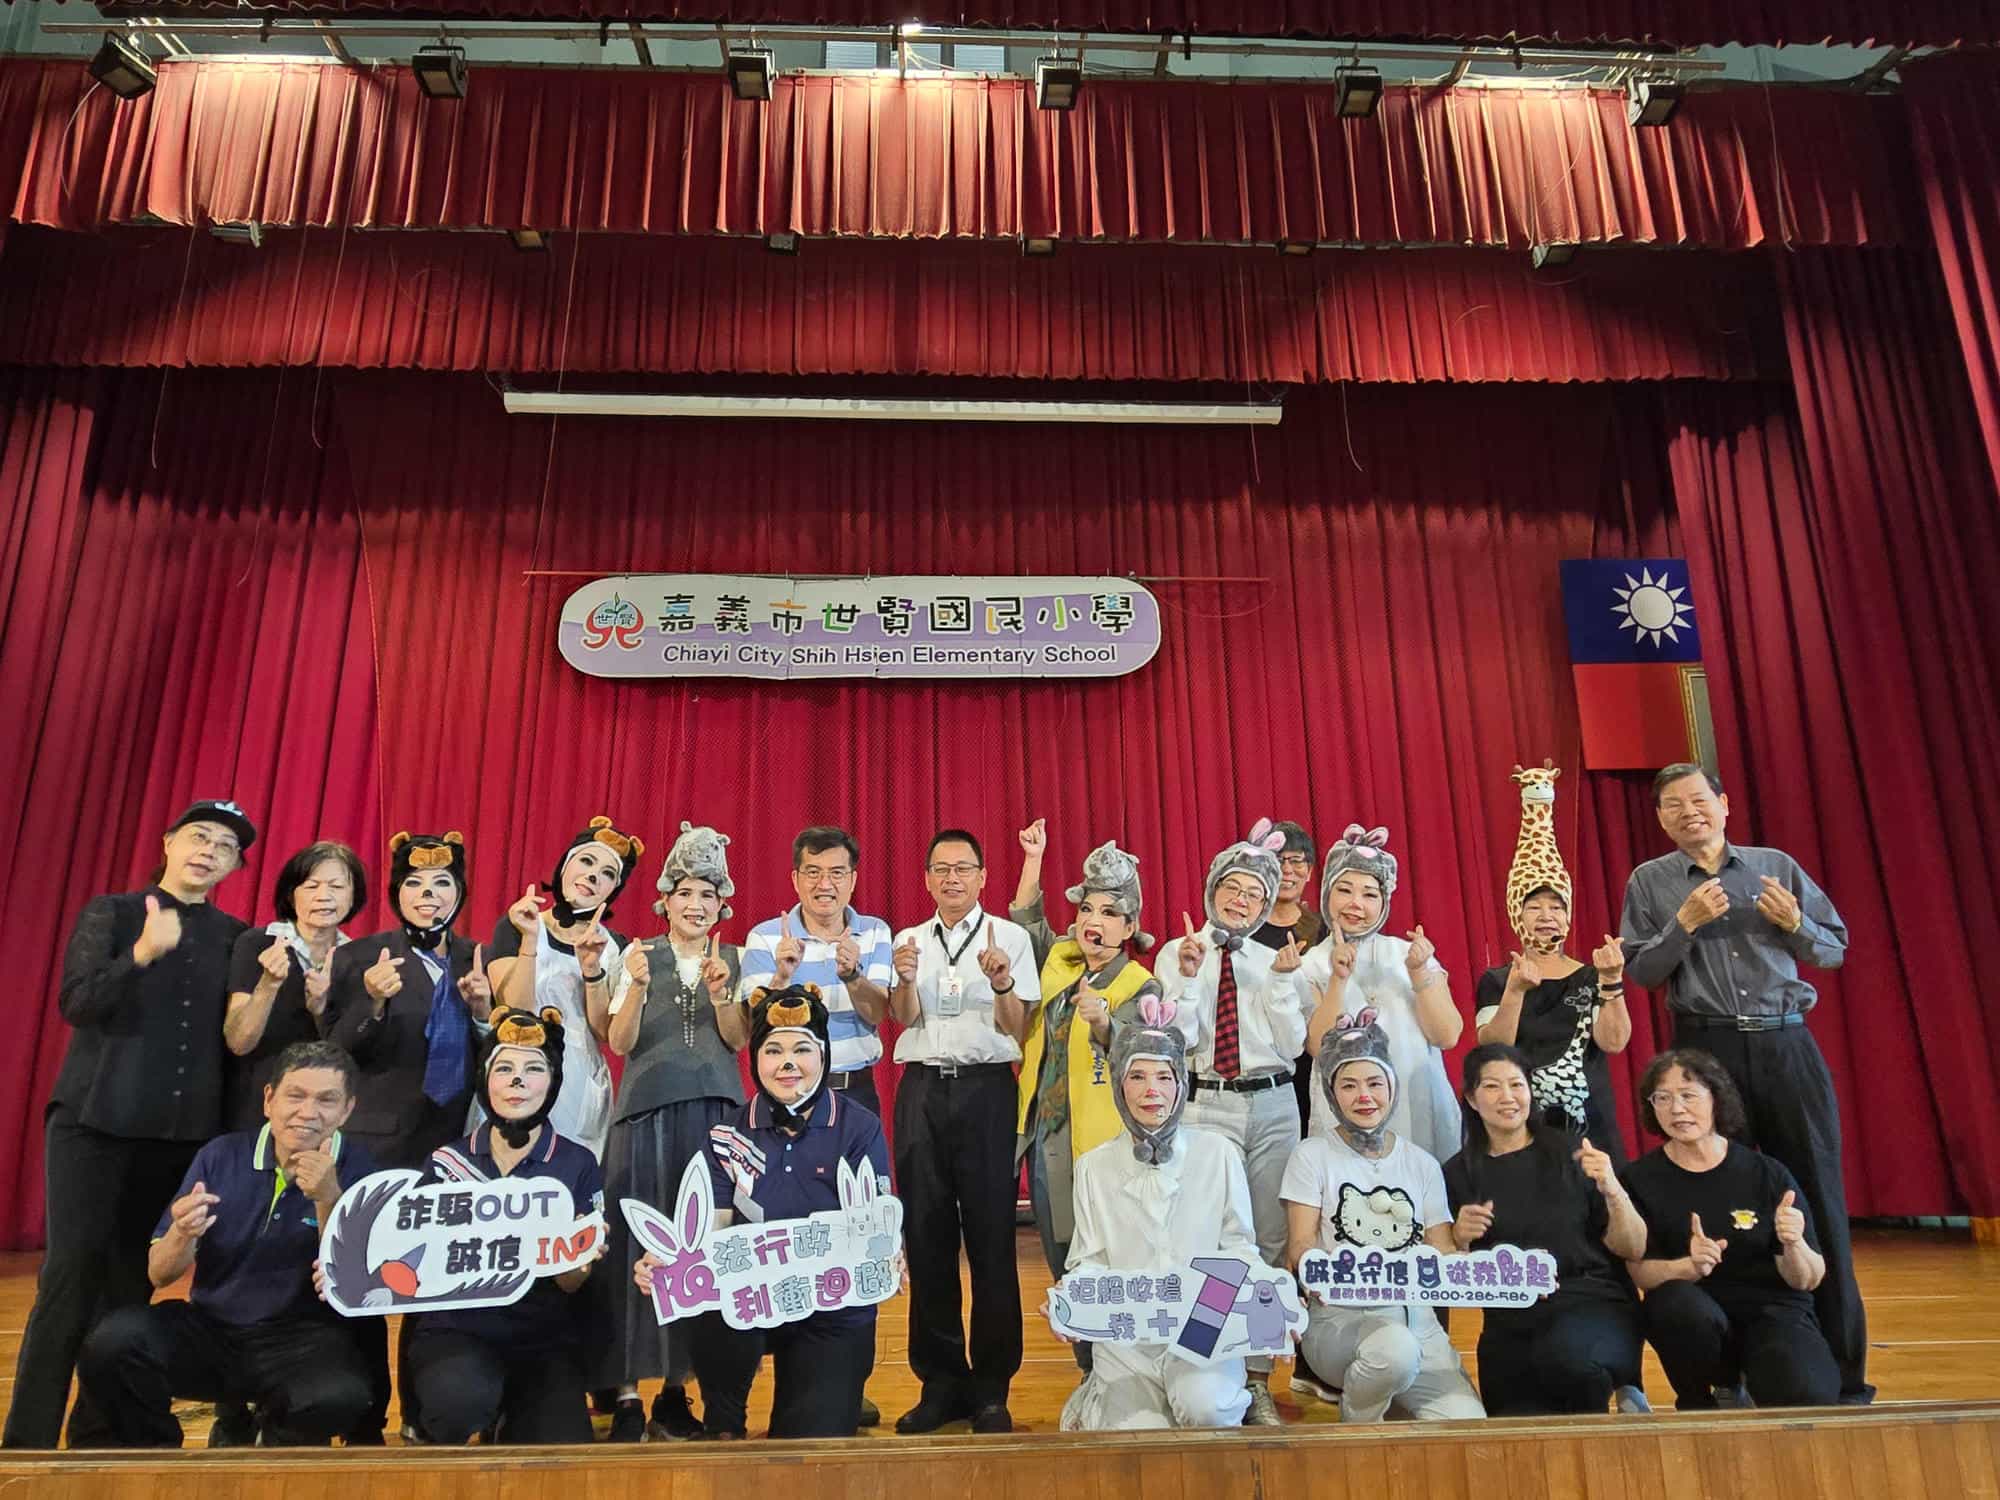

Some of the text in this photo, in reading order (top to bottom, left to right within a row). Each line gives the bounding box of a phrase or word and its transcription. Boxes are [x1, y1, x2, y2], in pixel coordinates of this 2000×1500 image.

[658, 593, 1133, 634] 嘉義市世賢國民小學
[663, 645, 1116, 666] Chiayi City Shih Hsien Elementary School
[446, 1234, 521, 1274] 誠信
[1068, 1273, 1182, 1304] 拒絕收禮
